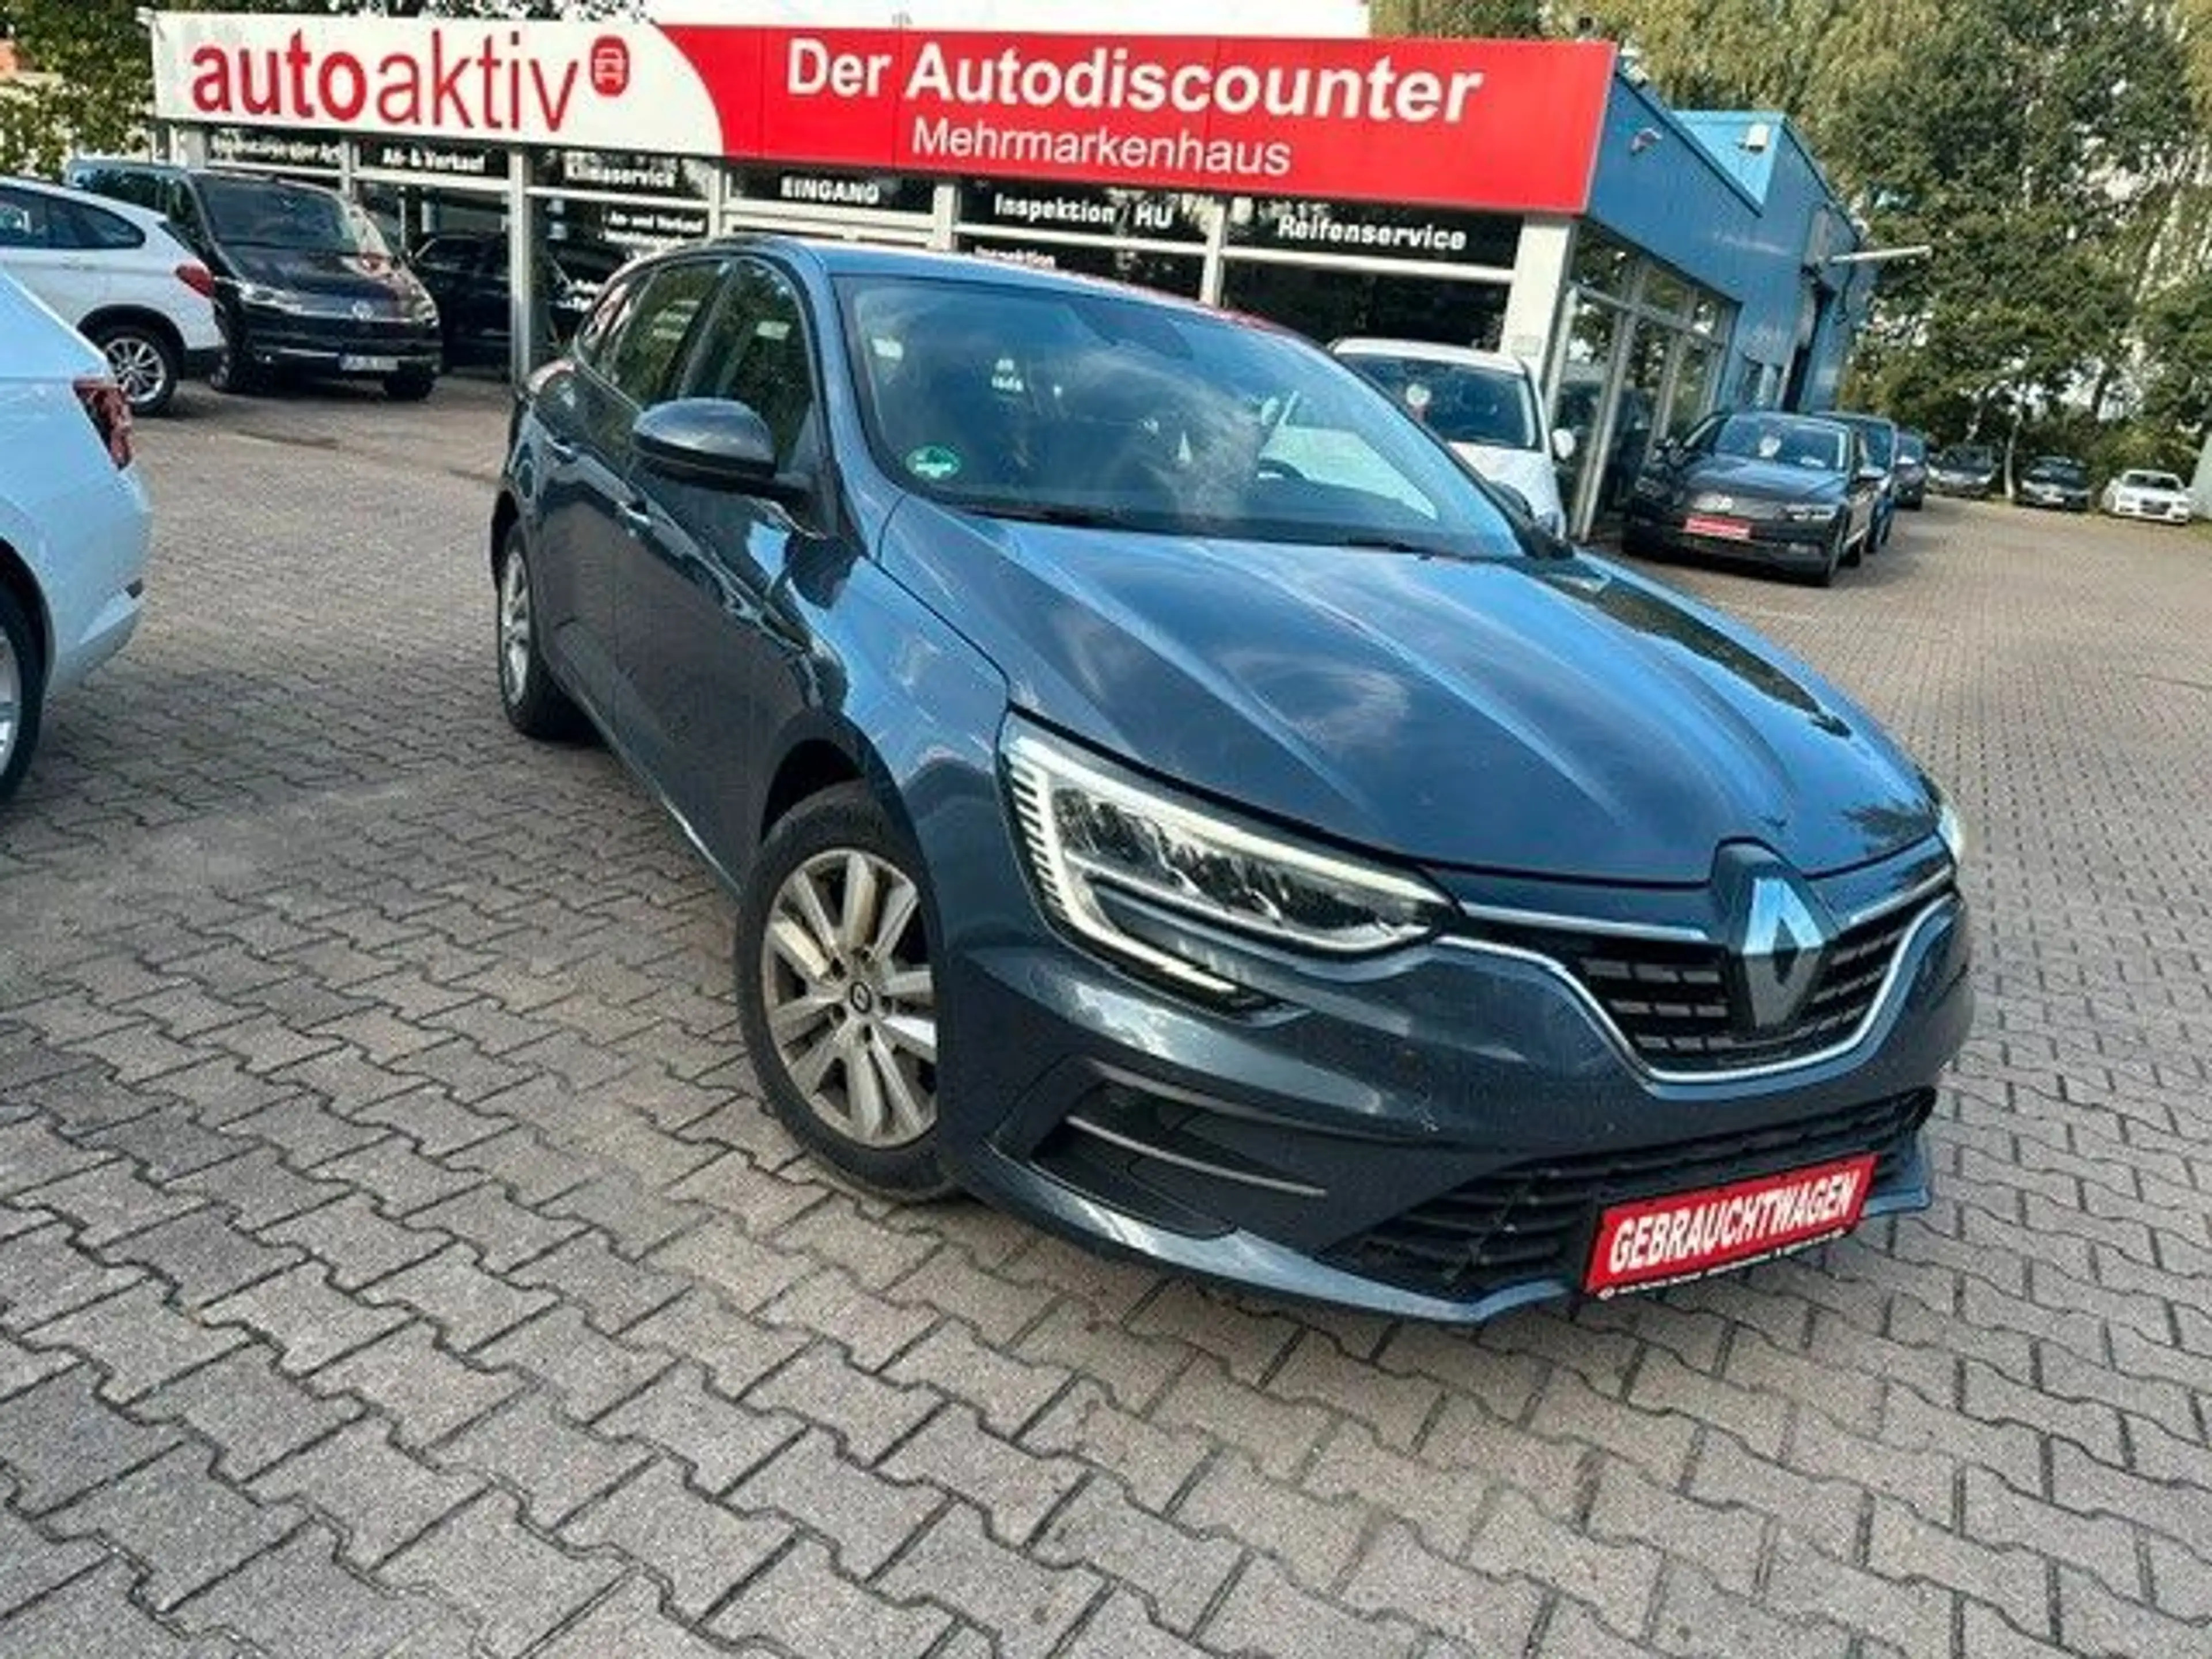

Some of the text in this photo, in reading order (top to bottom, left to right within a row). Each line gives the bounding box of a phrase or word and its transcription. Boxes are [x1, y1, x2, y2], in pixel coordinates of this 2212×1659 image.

[192, 29, 579, 132] autoaktiv
[787, 37, 1484, 123] Der Autodiscounter
[911, 117, 1291, 175] Mehrmarkenhaus
[781, 176, 880, 204] EINGANG
[994, 192, 1173, 229] Inspektion HU
[1278, 213, 1467, 251] Reifenservice
[1609, 1172, 1861, 1273] GEBRAUCHTWAGEN
